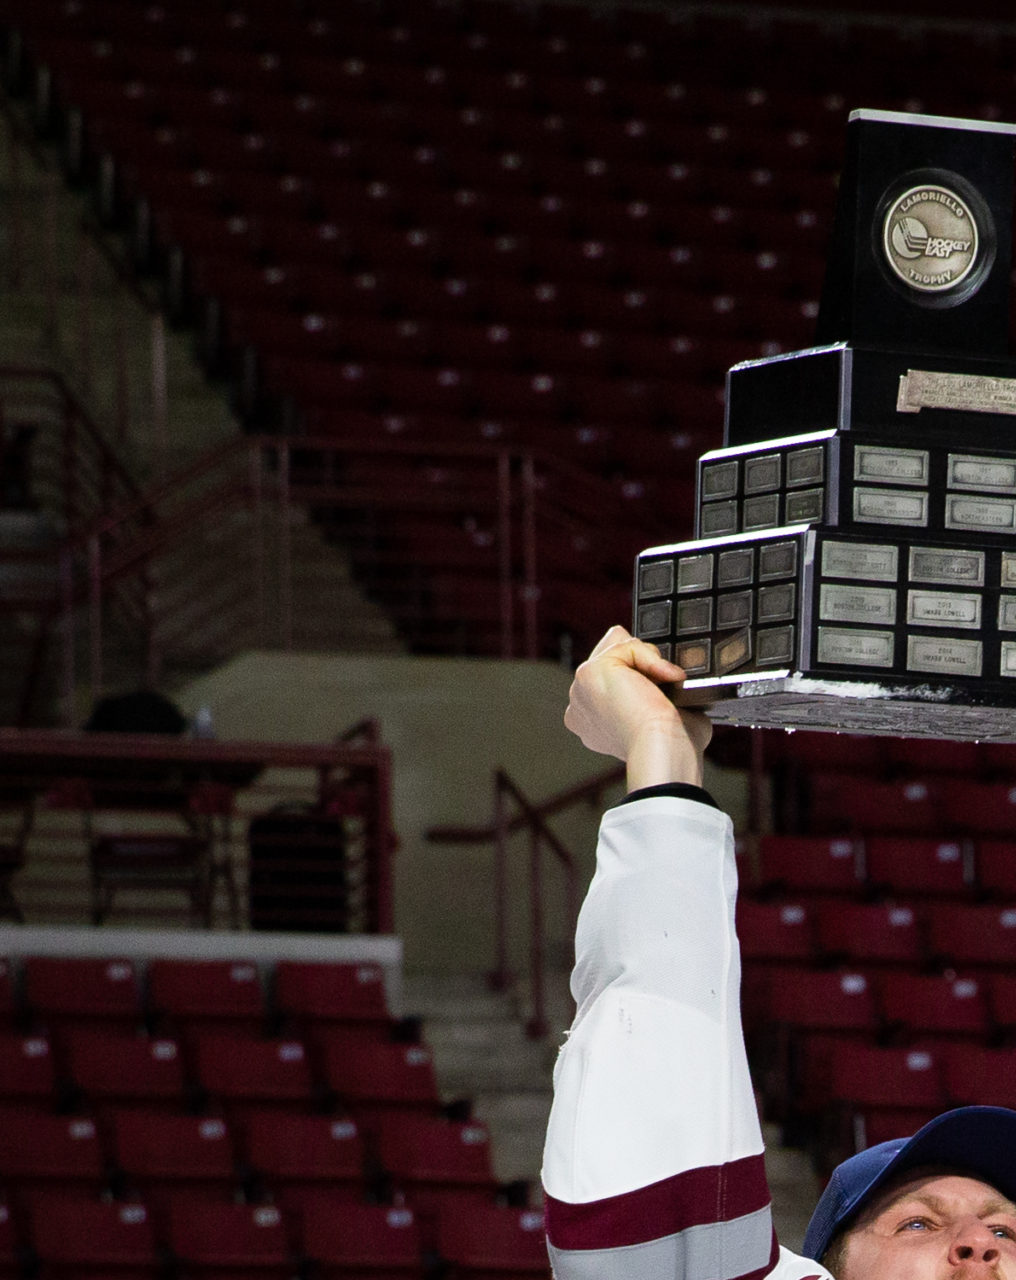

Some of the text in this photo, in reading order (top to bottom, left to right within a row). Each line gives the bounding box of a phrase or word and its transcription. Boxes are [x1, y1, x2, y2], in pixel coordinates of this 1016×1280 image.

[900, 191, 964, 217] LAMORIELLO
[926, 237, 970, 252] HOCKEY
[925, 247, 952, 258] EAST
[909, 269, 952, 284] TROPHY
[943, 610, 966, 618] LOWELL
